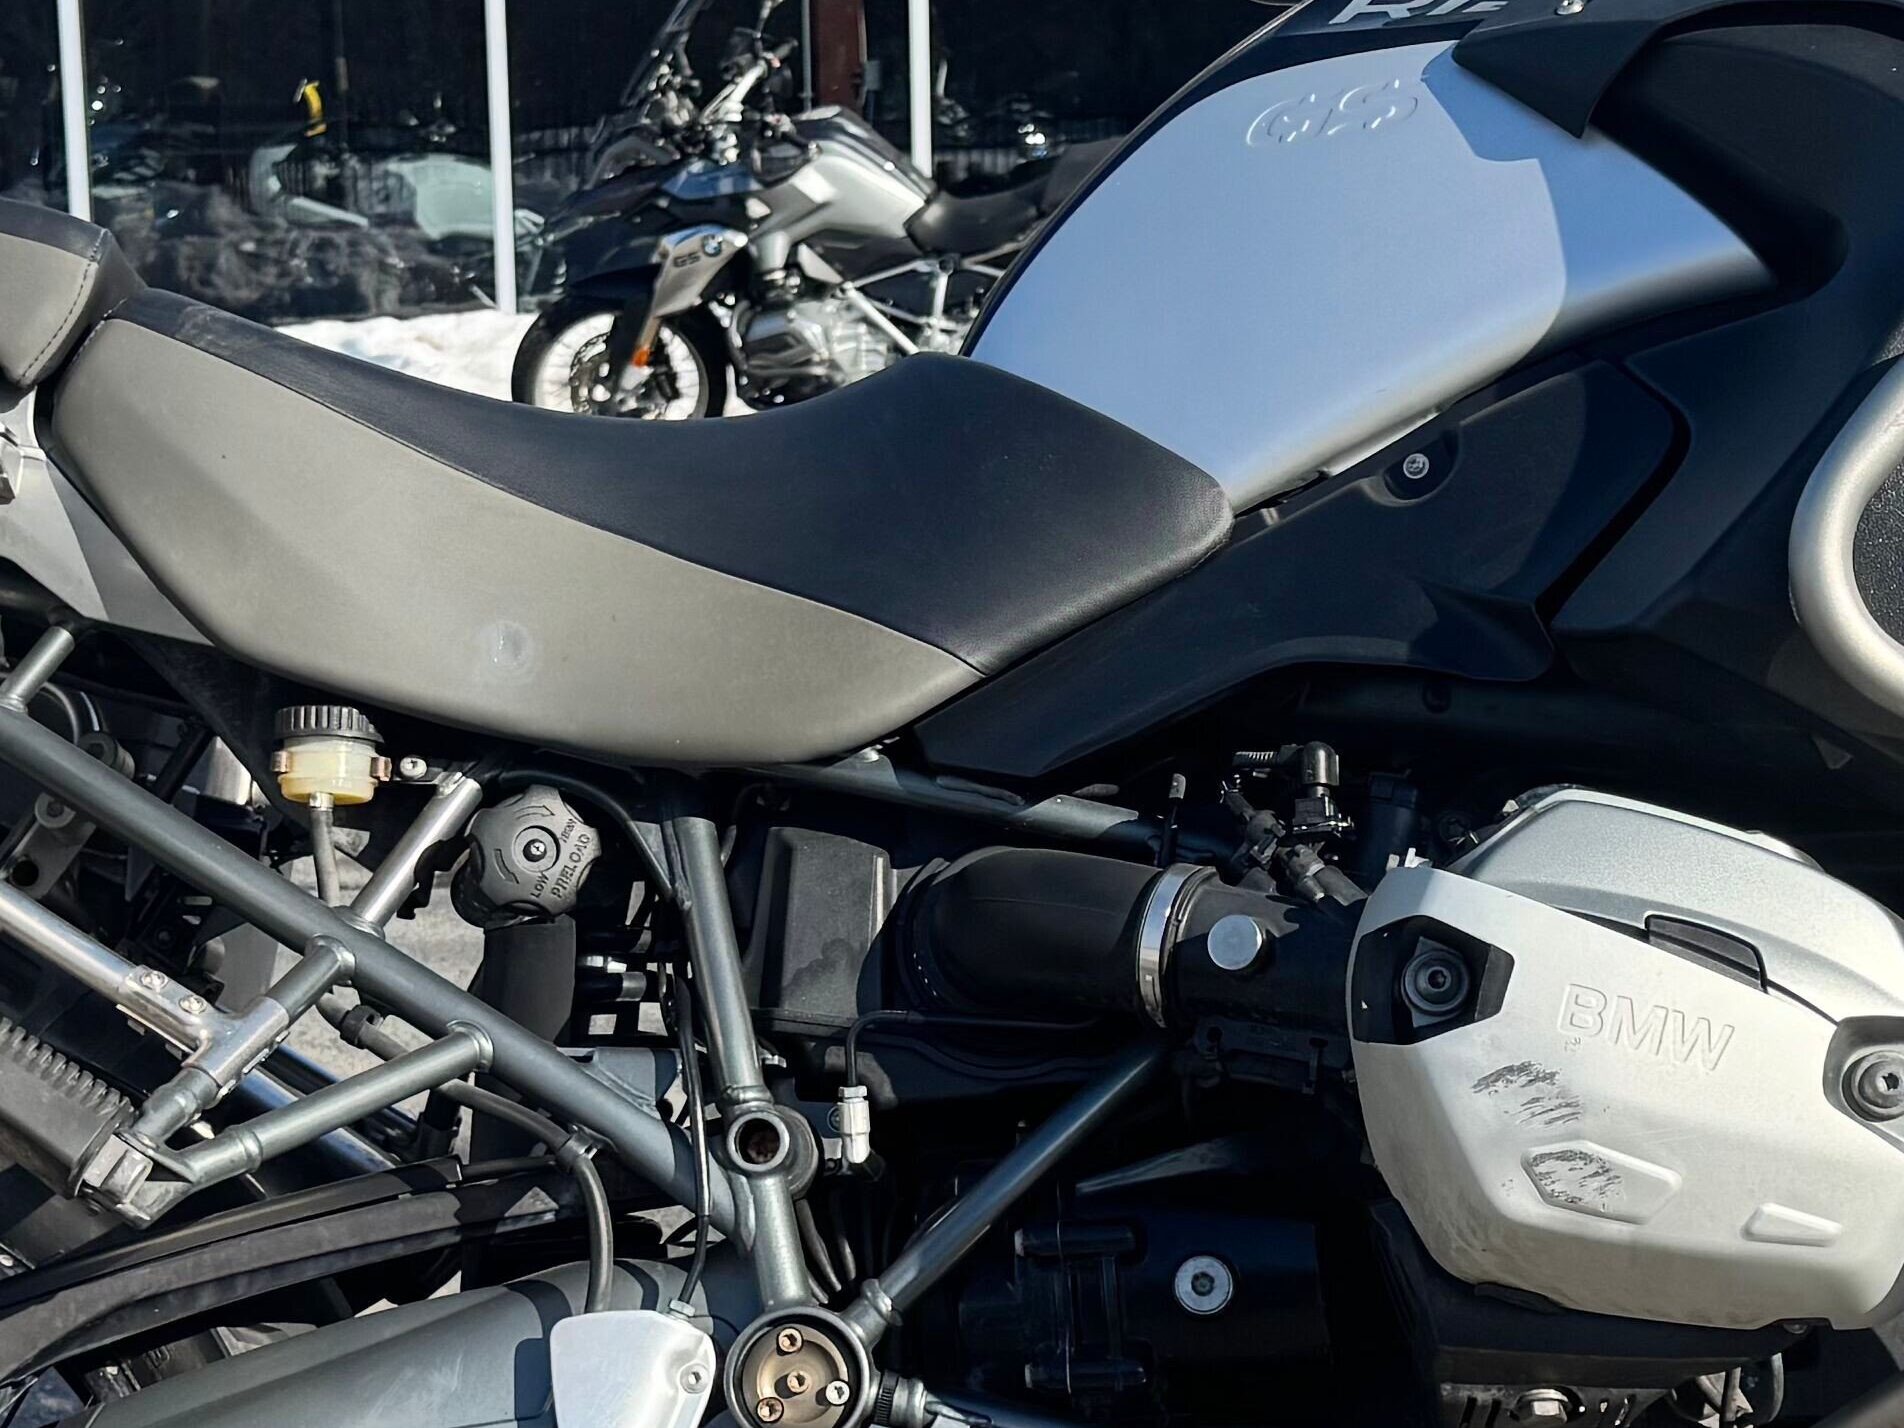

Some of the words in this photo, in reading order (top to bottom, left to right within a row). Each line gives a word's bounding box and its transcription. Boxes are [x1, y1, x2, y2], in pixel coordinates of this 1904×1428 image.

[1246, 77, 1419, 147] GS
[673, 251, 701, 268] GS
[530, 872, 550, 898] LOW
[550, 833, 591, 899] PRELOAD
[1556, 982, 1736, 1072] BMW
